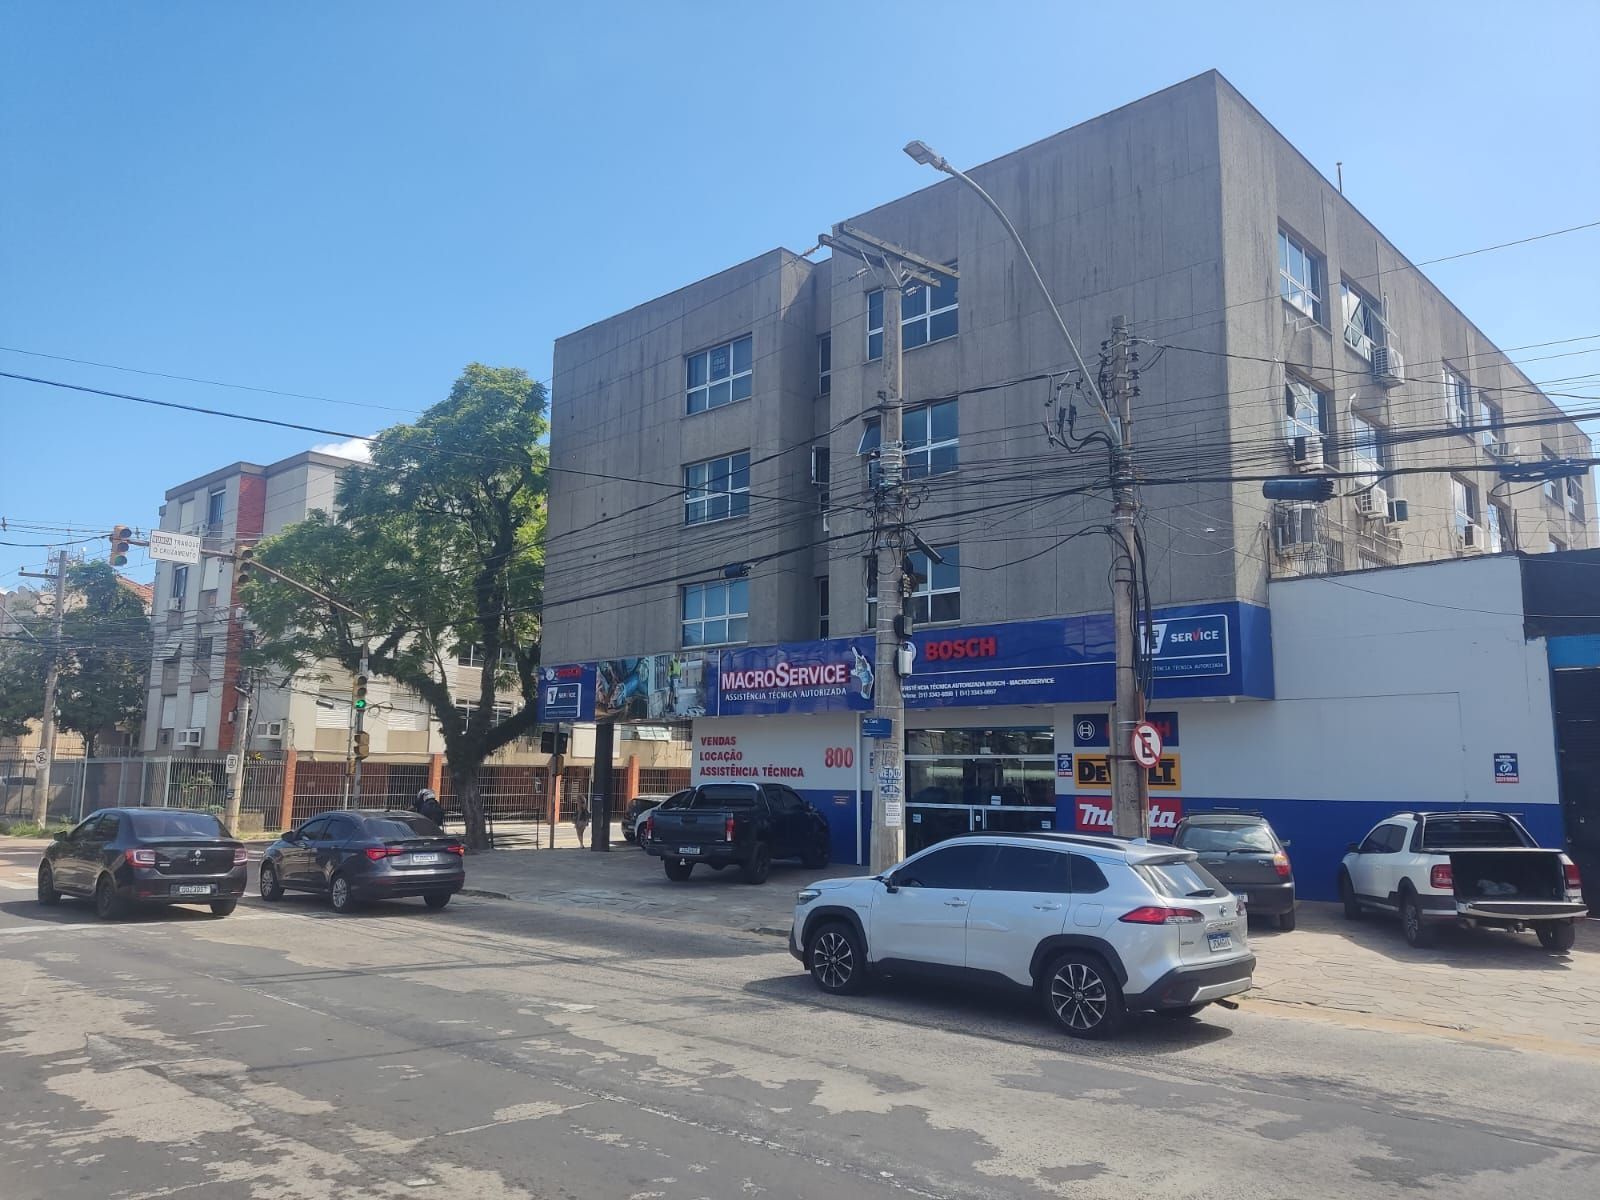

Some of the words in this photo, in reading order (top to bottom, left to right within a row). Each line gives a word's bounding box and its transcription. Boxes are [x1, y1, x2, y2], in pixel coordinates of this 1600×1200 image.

[1170, 628, 1219, 643] SERVICE
[925, 637, 997, 661] BOSCH
[725, 690, 766, 701] ASSISTÊNCIA
[768, 690, 798, 700] TÉCNICA
[800, 687, 847, 698] AUTORIZADA
[700, 736, 737, 747] VENDAS
[699, 749, 743, 762] LOCAÇÃO
[824, 748, 854, 768] 800
[699, 764, 760, 778] ASSISTÊNCIA
[761, 764, 805, 778] TÉCNICA
